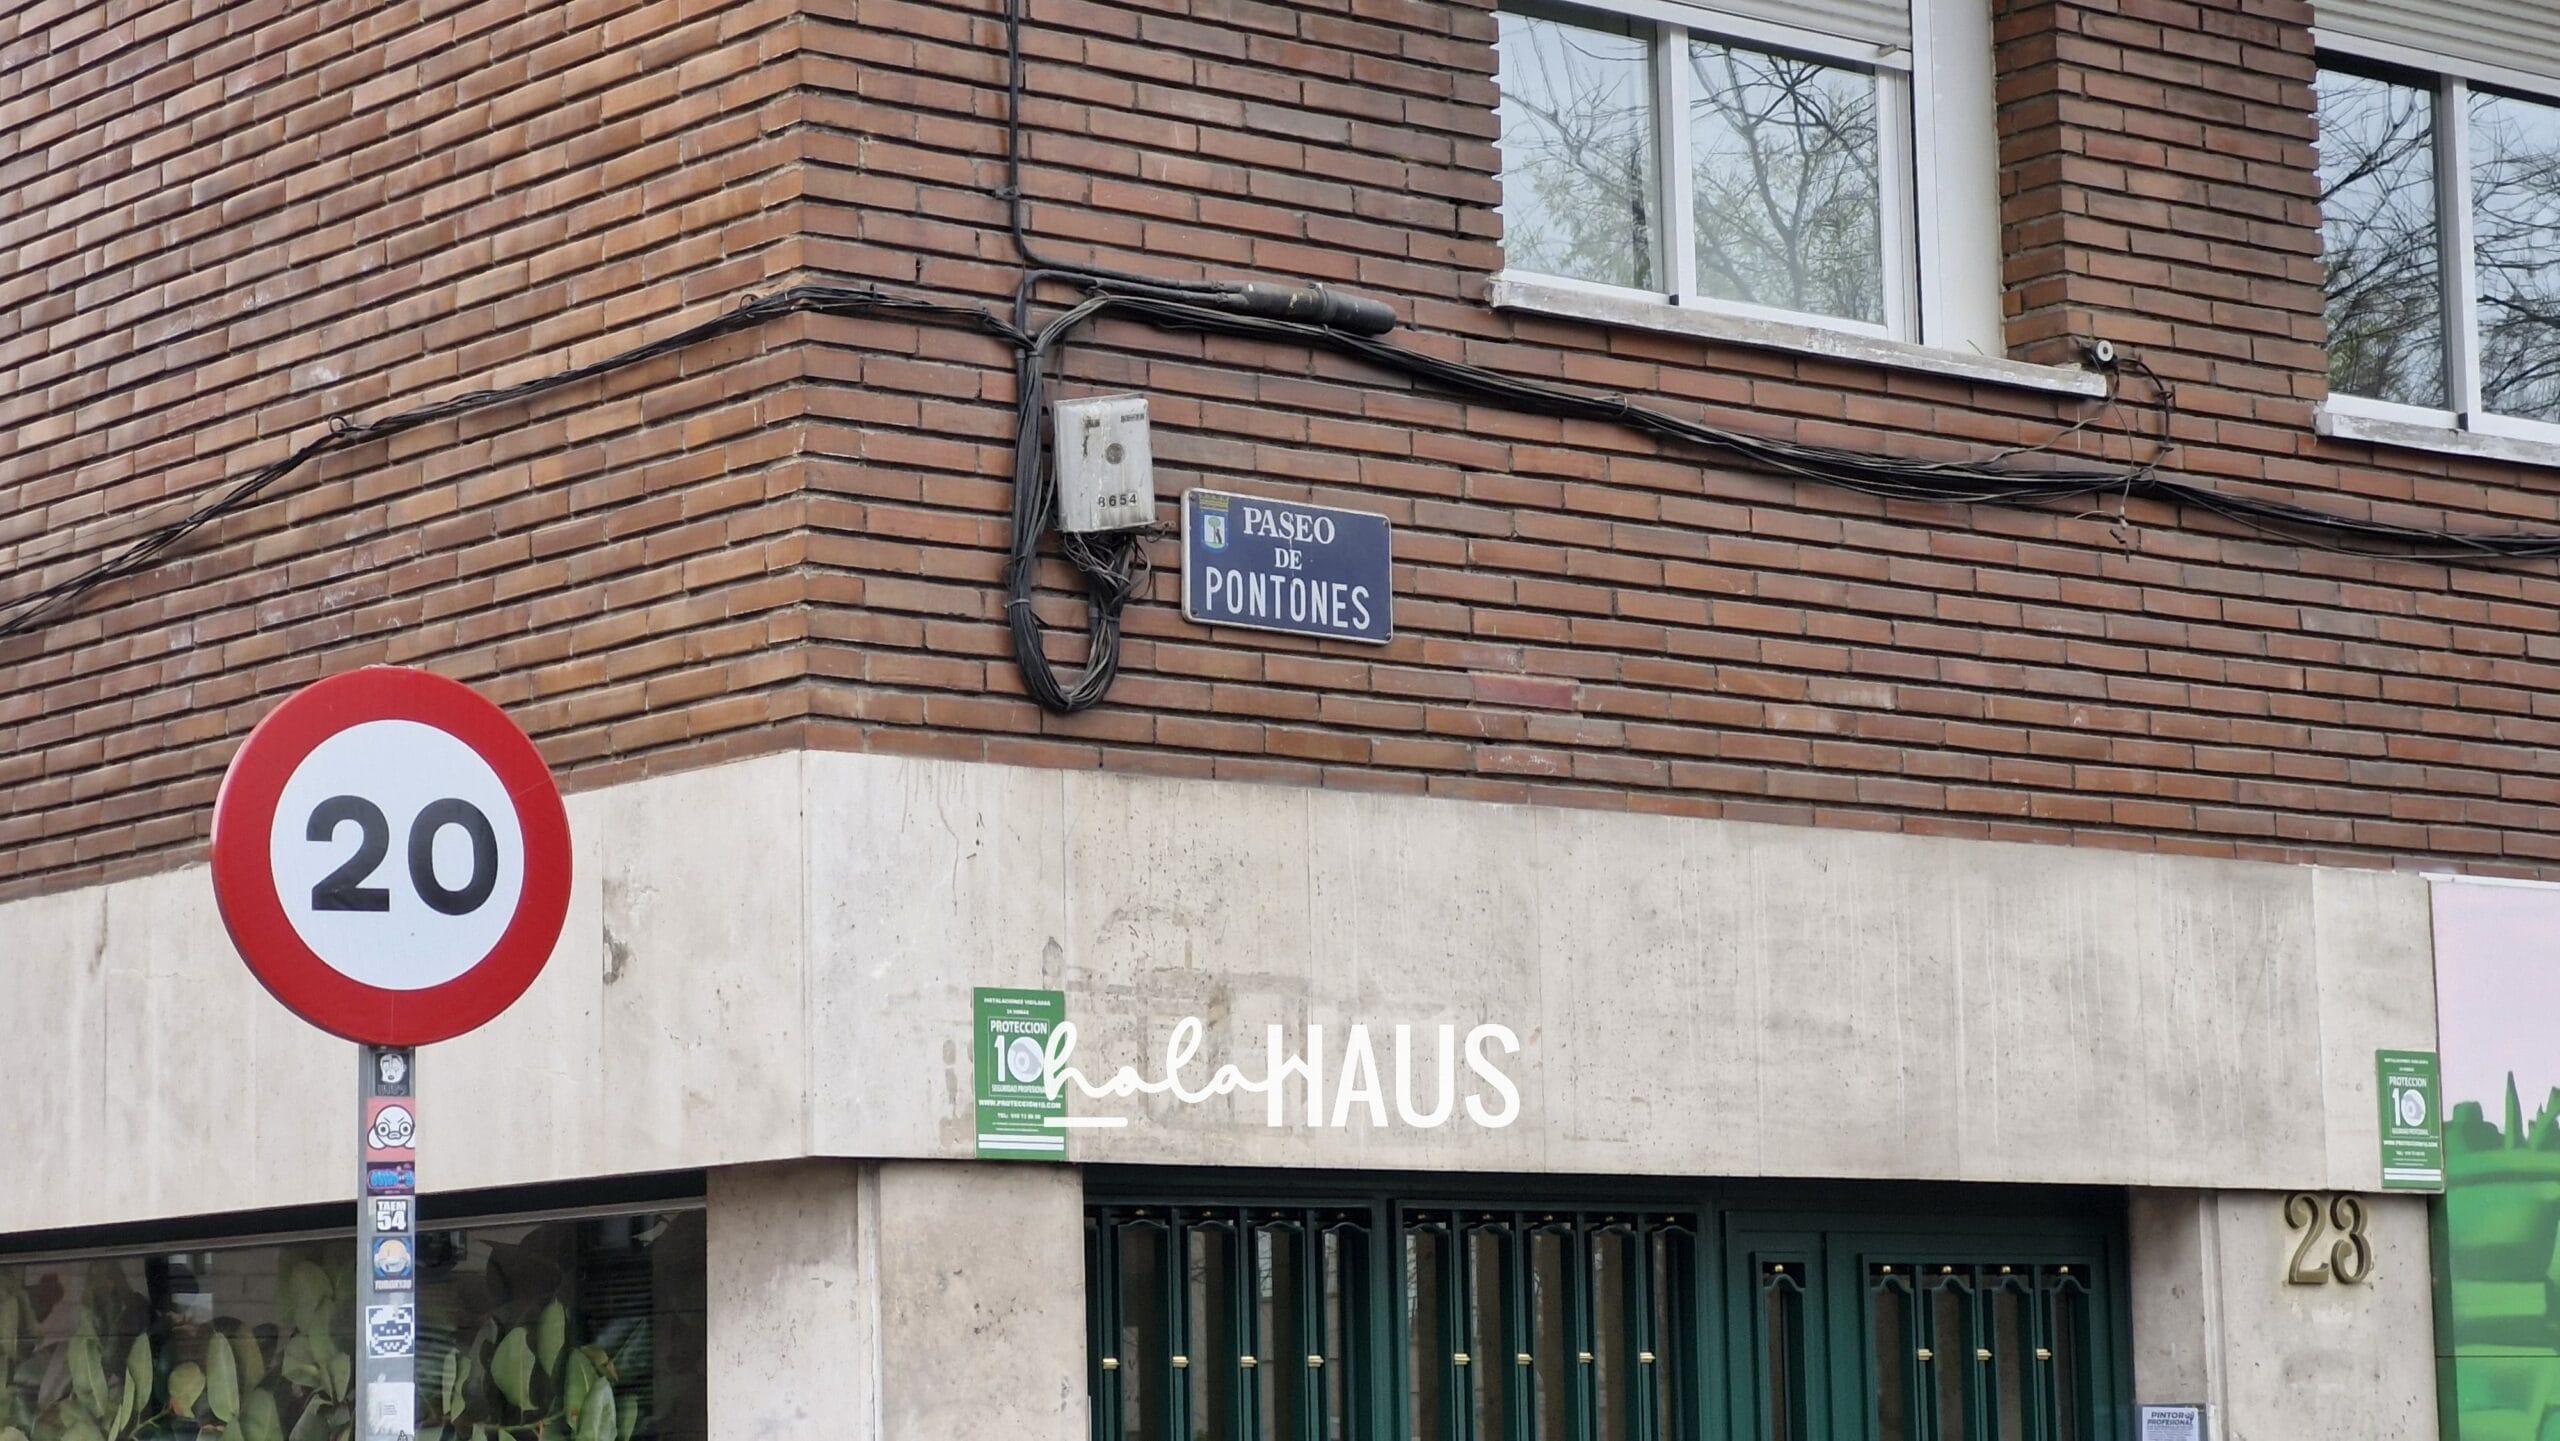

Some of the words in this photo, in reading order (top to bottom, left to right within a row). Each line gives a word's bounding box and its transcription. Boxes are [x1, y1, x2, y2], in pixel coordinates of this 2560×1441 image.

[1097, 493, 1137, 508] 8654
[1243, 507, 1336, 545] PASEO
[1275, 548, 1303, 571] DE
[1205, 566, 1370, 631] PONTONES
[306, 794, 499, 916] 20
[990, 1019, 1048, 1036] PROTECCION
[994, 1034, 1045, 1083] 10
[377, 1200, 407, 1211] TAEM
[377, 1210, 407, 1231] 54
[2283, 1190, 2372, 1286] 23
[2151, 1411, 2185, 1419] PINTOR
